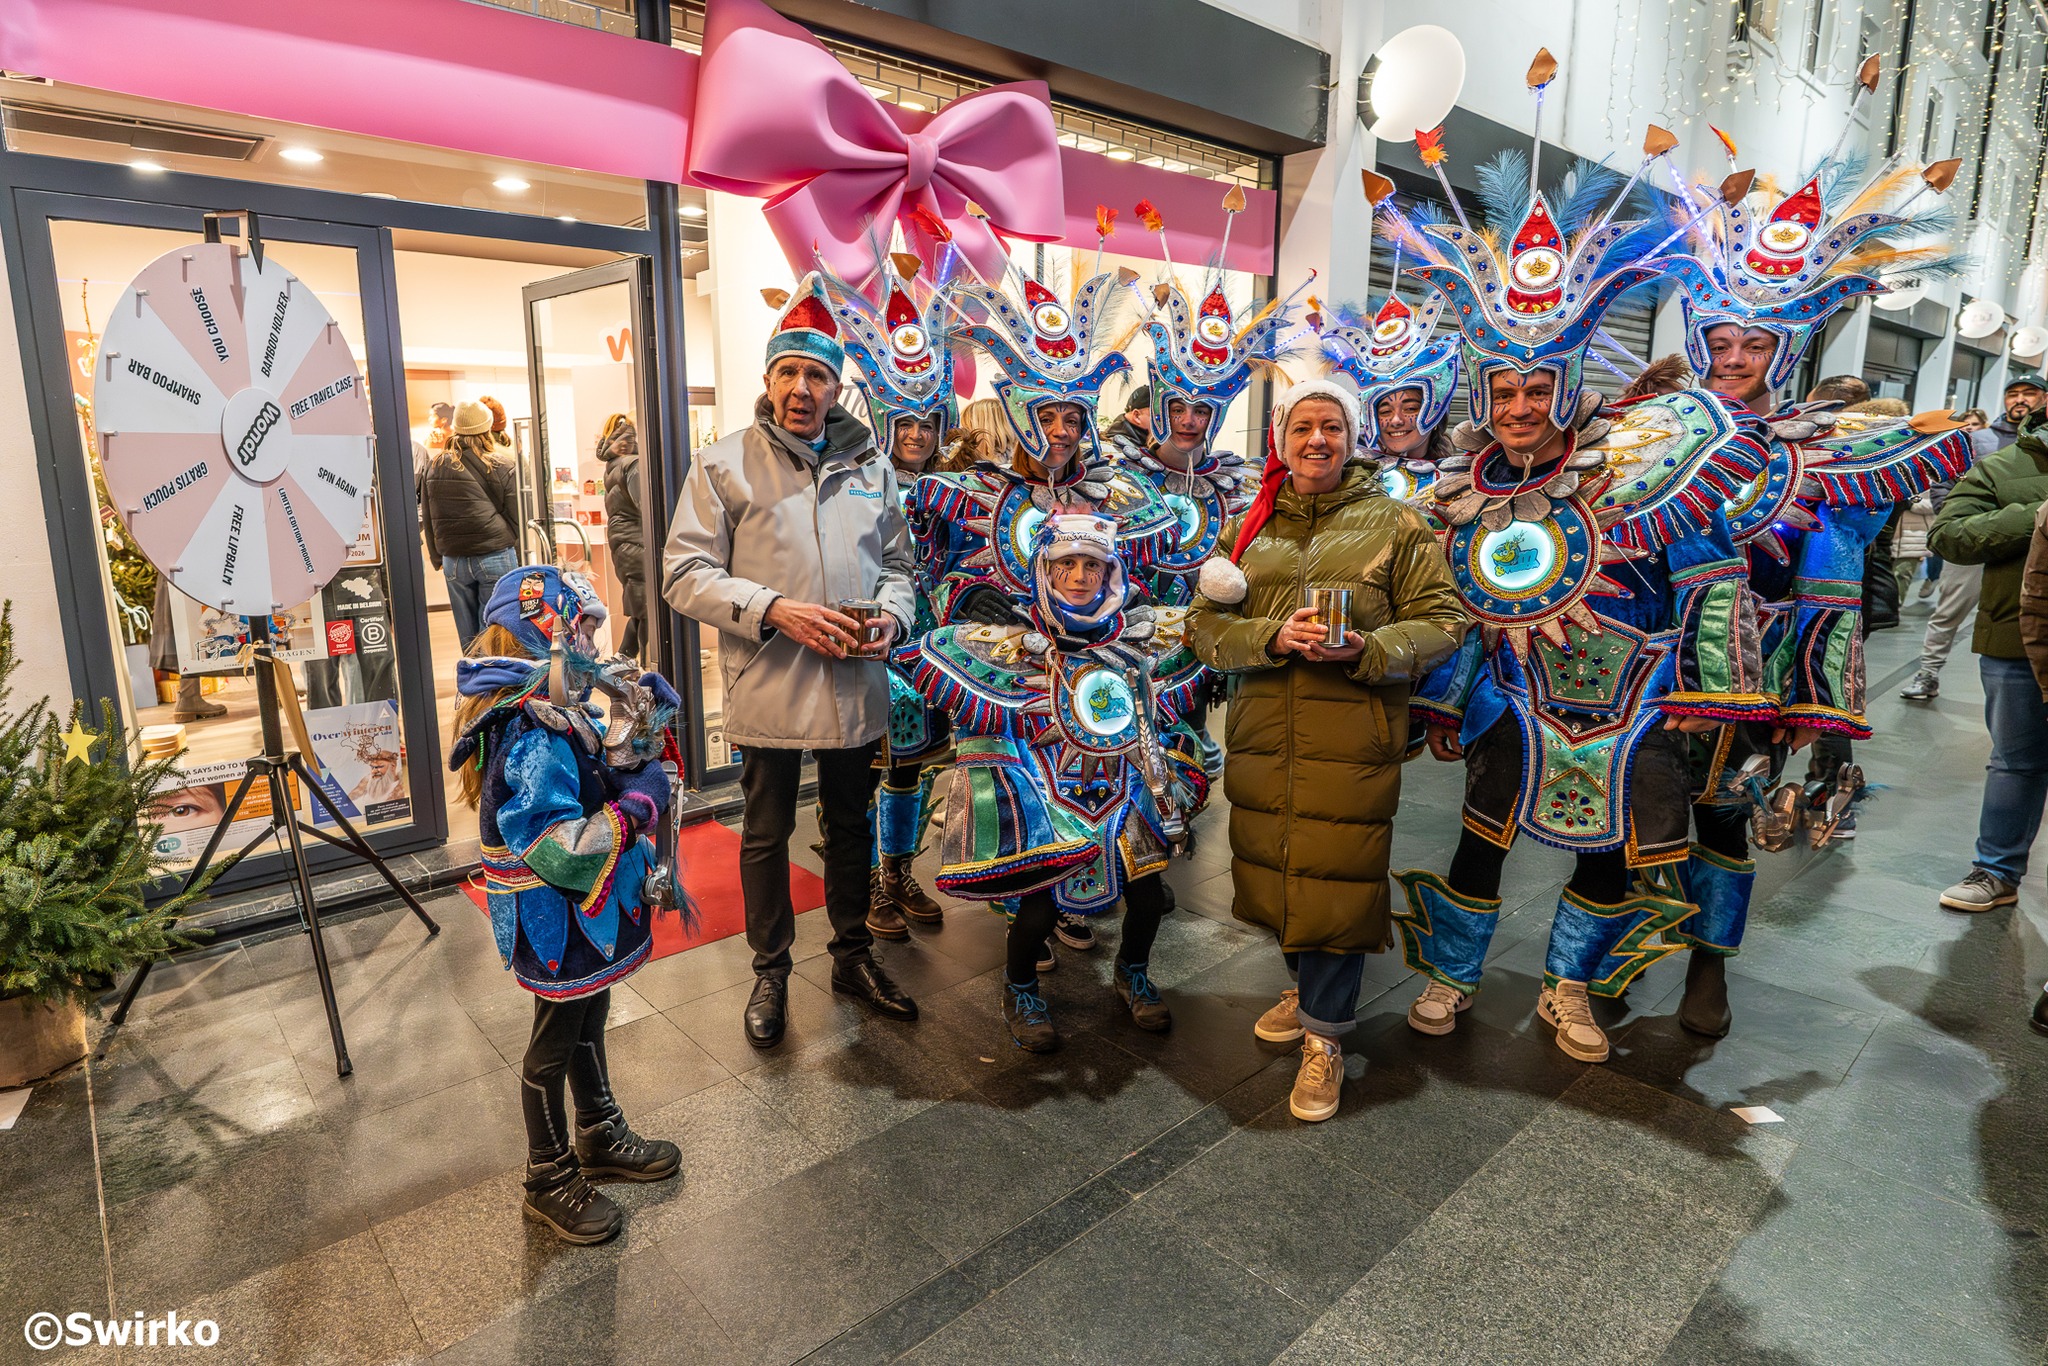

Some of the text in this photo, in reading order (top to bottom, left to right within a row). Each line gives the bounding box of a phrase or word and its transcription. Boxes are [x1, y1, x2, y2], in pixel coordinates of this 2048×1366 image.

[192, 287, 229, 362] YOU CHOOSE
[261, 291, 289, 378] BAMBOO HOLDER
[128, 358, 201, 405] SHAMPOO BAR
[290, 376, 353, 417] FREE TRAVEL CASE
[143, 461, 208, 511] GRATIS POUCH
[318, 467, 358, 498] SPIN AGAIN
[222, 504, 244, 586] FREE LIPBALM
[278, 487, 315, 574] LIMITED EDITION PRODUCT
[176, 776, 206, 787] Against
[206, 772, 232, 783] women
[192, 766, 213, 776] SAYS
[213, 764, 226, 772] NO
[227, 762, 238, 770] TO
[160, 841, 178, 850] 1712
